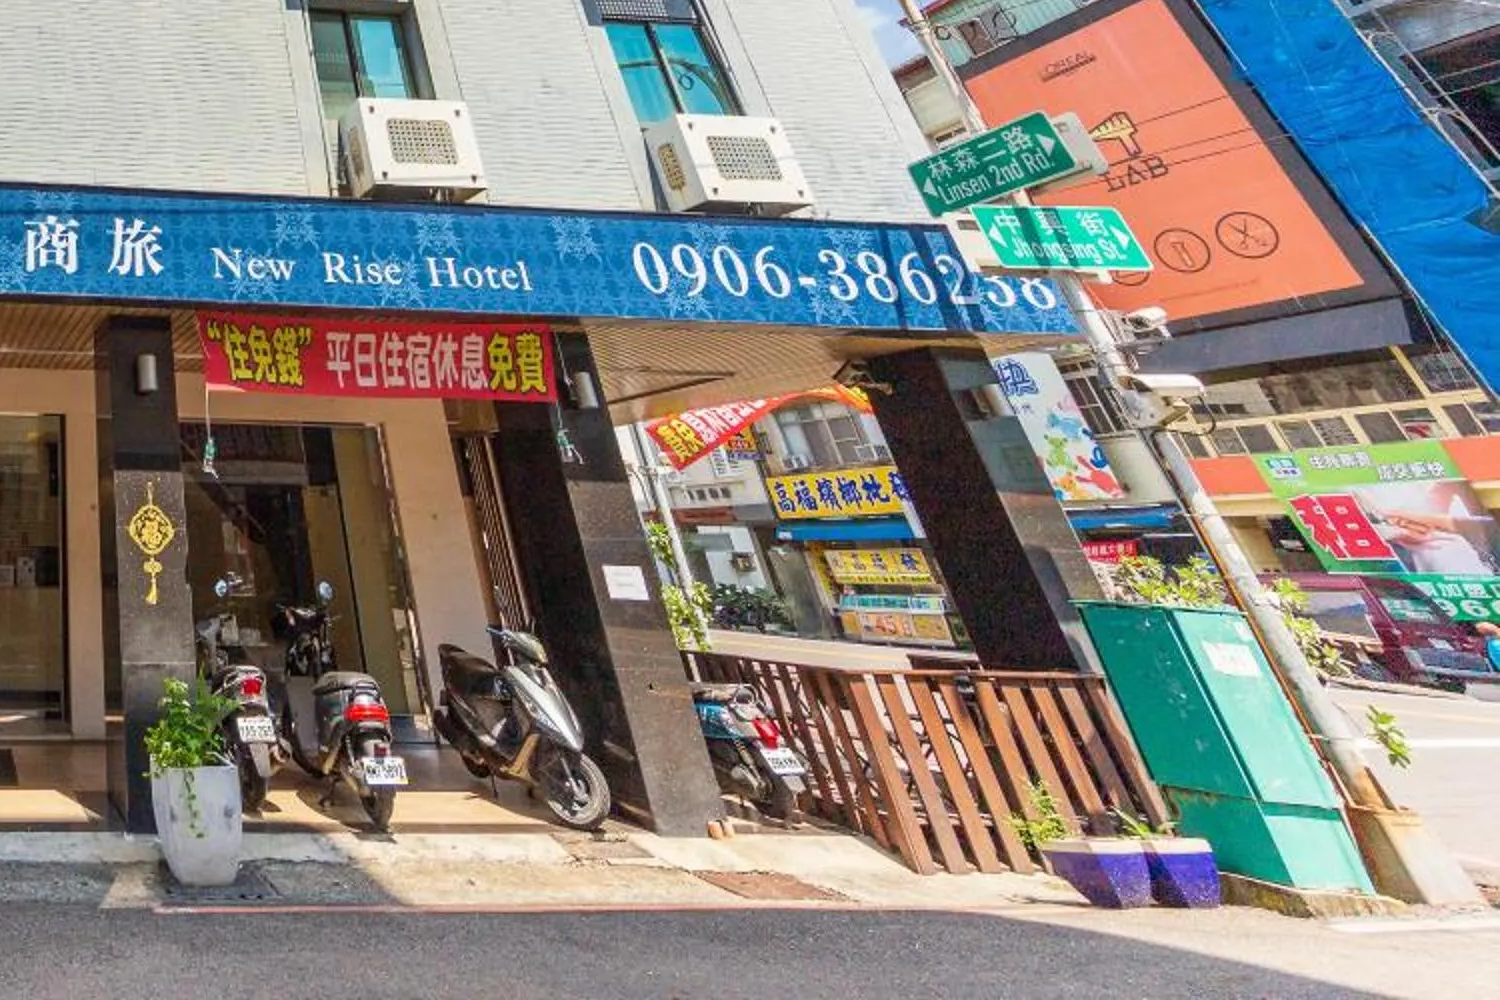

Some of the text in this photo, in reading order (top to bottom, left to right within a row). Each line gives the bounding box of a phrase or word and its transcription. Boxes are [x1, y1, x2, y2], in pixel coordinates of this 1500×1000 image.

[927, 126, 1035, 182] 林森二路
[1103, 153, 1169, 193] LAB
[937, 148, 1056, 206] Linsen 2nd Rd.
[995, 209, 1109, 238] 中興街
[211, 246, 534, 291] New Rise Hotel
[1011, 237, 1126, 266] Jhongsing St.
[326, 330, 548, 394] 平日住宿休息免費
